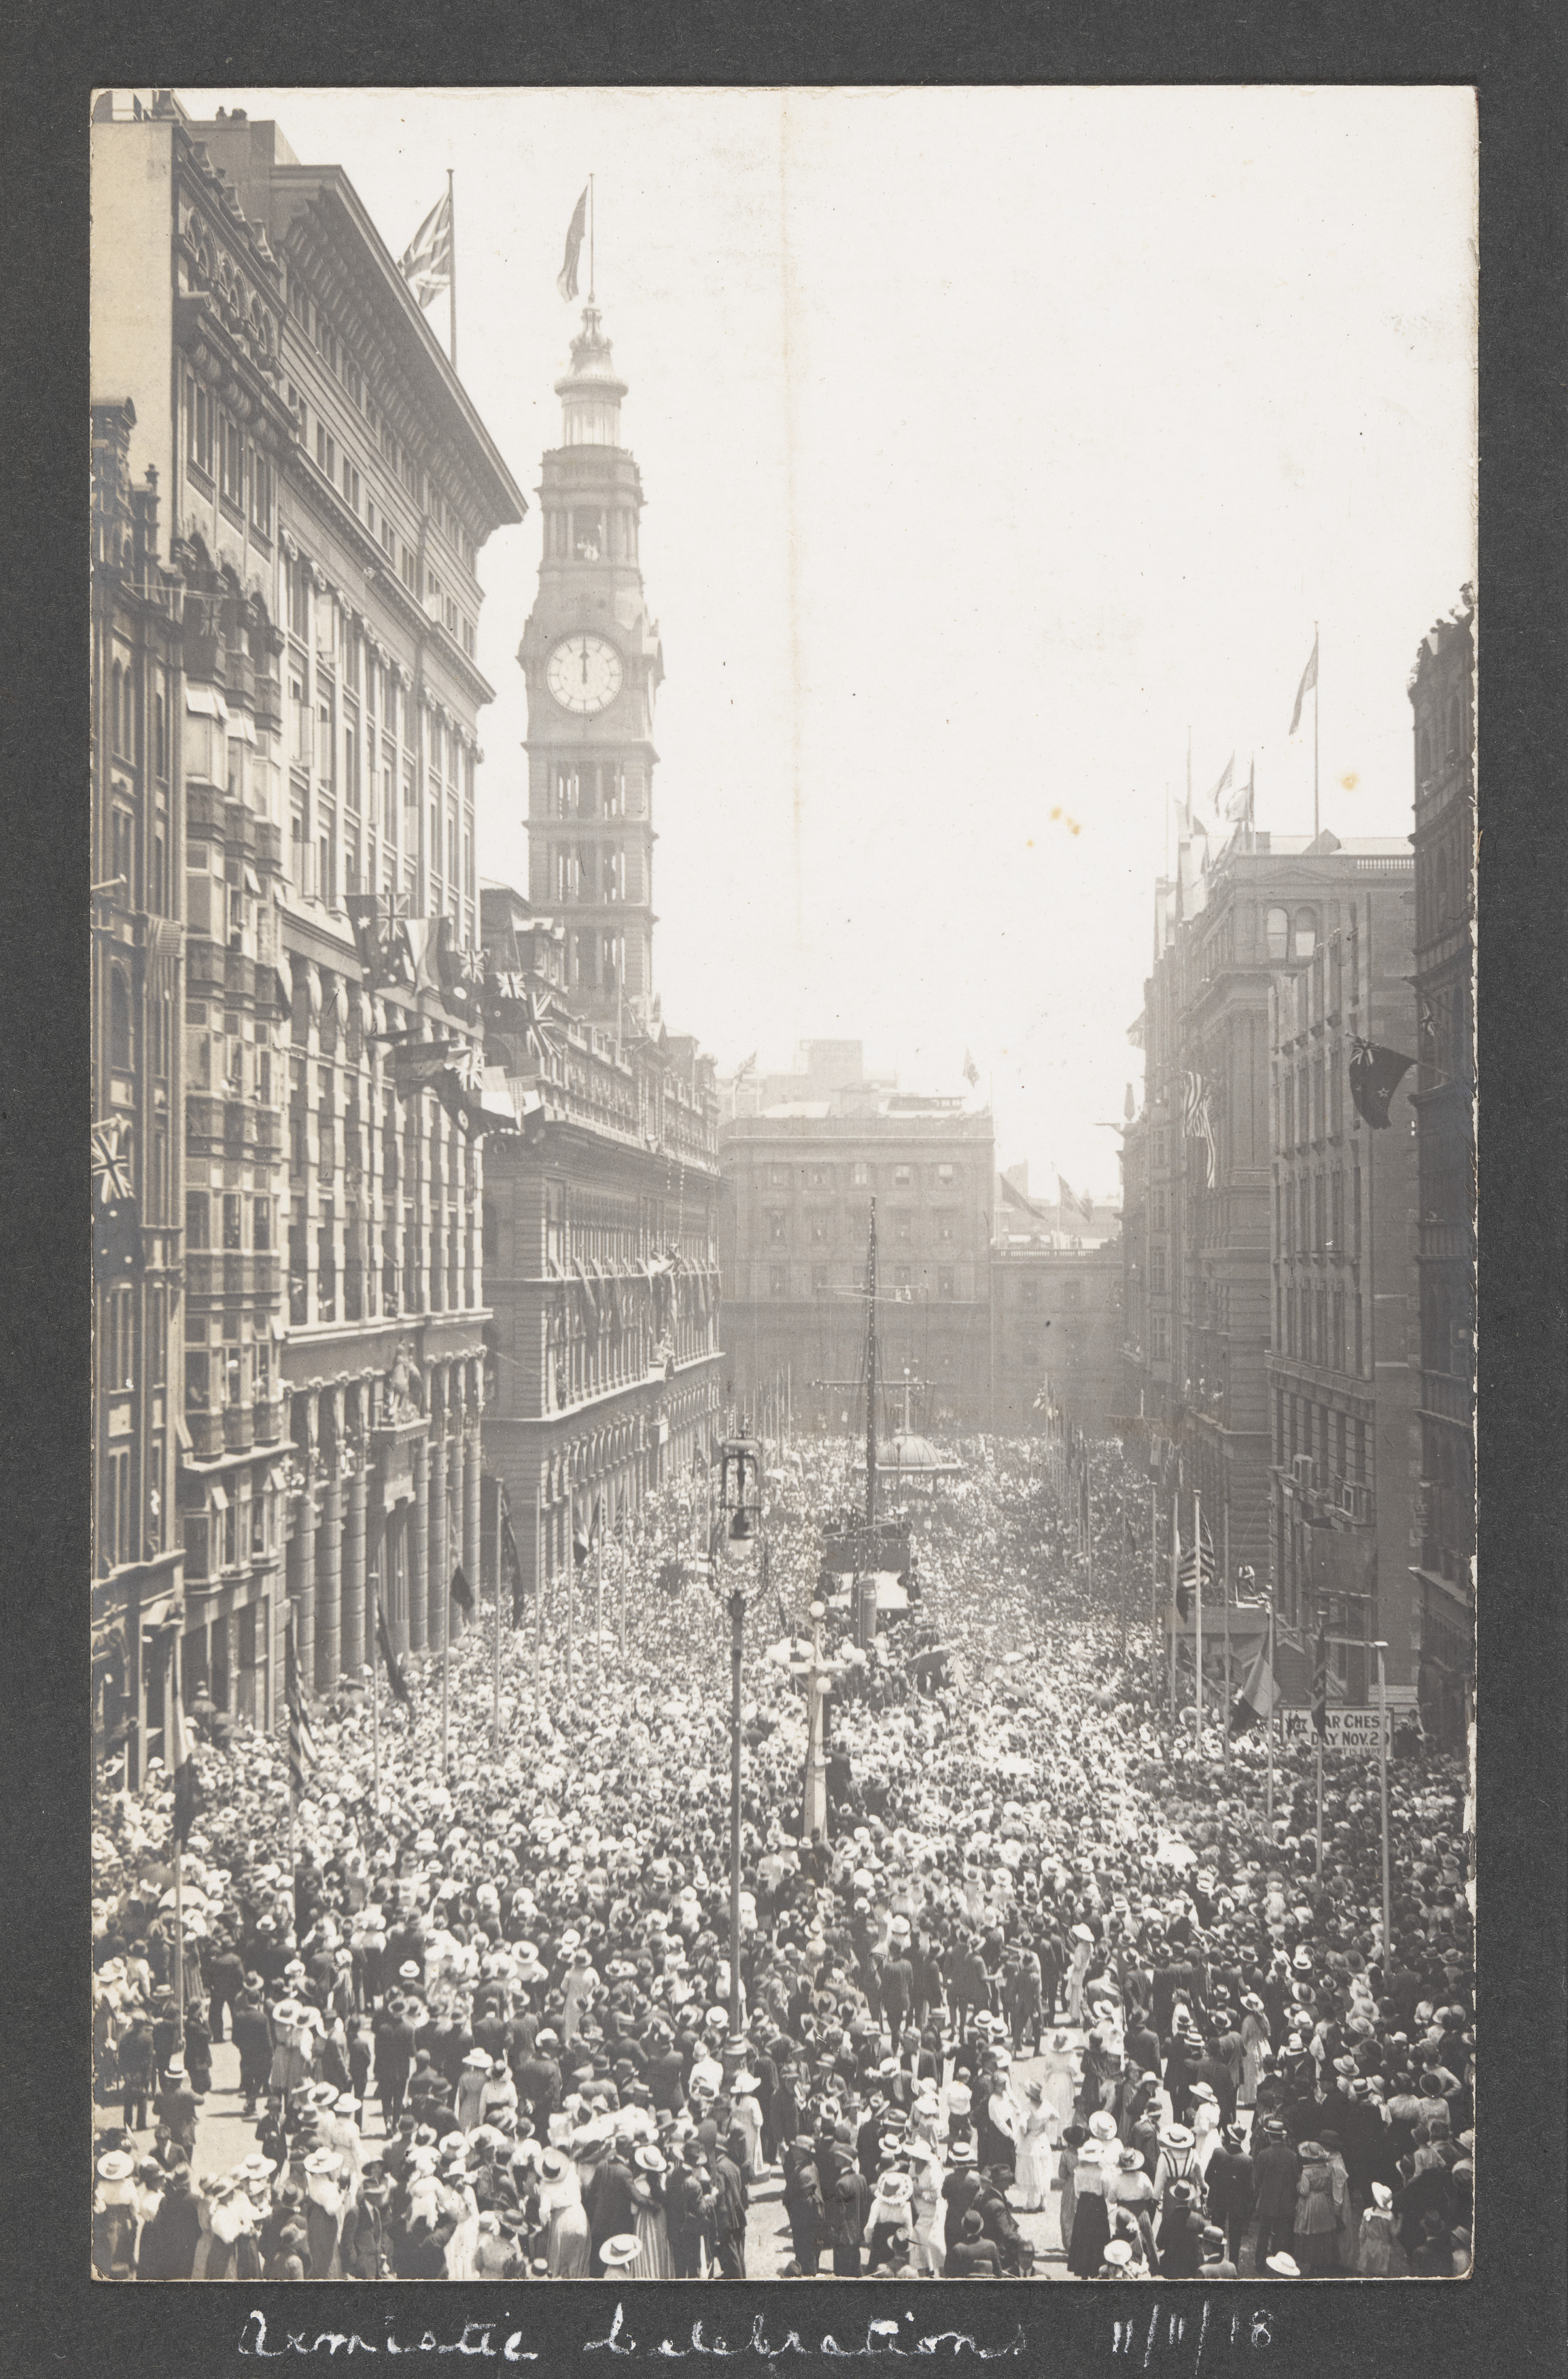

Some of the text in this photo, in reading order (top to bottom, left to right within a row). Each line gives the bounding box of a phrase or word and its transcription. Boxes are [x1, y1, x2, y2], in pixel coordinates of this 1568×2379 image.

[1311, 1731, 1339, 1746] DAY
[1342, 1731, 1368, 1746] NOV.
[1360, 1748, 1380, 1756] EMPT
